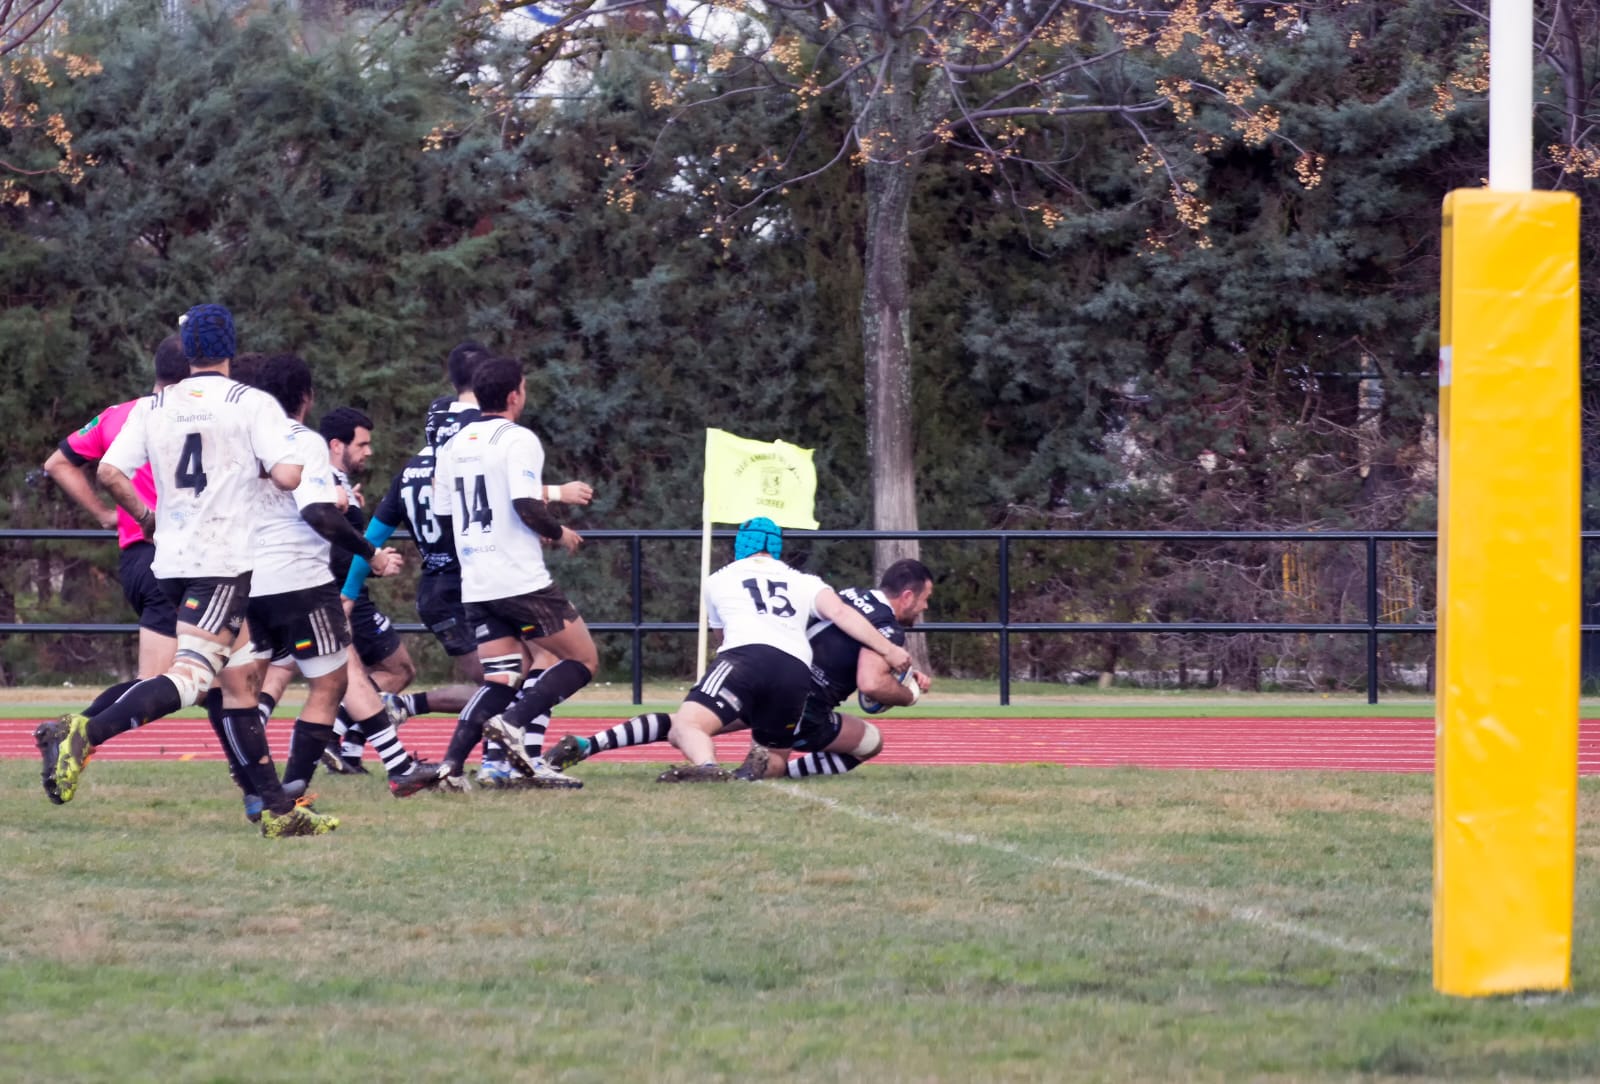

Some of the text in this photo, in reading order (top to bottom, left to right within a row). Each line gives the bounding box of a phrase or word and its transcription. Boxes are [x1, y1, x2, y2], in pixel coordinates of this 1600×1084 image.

[175, 432, 207, 497] 4
[400, 485, 442, 543] 13
[454, 474, 493, 536] 14
[741, 577, 797, 618] 15
